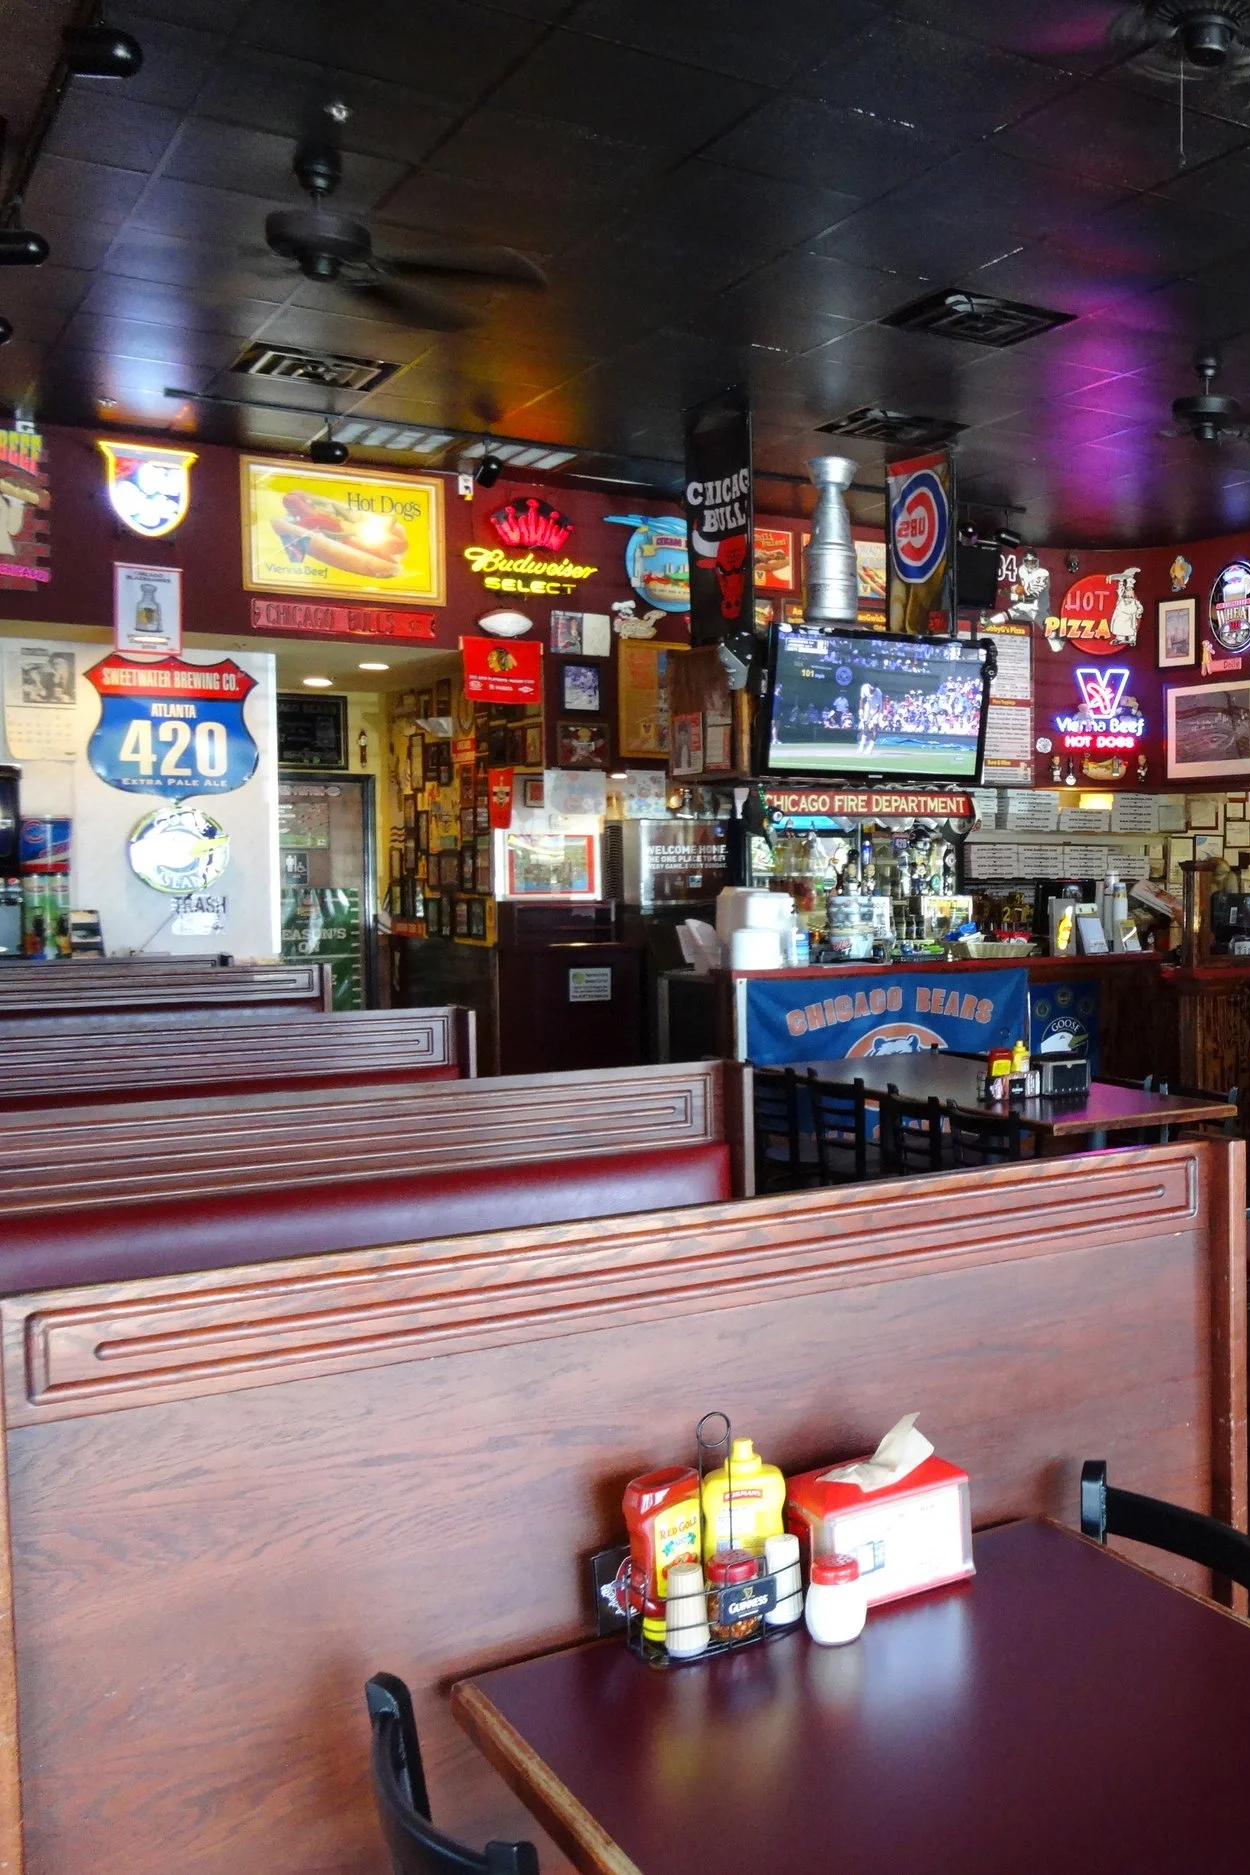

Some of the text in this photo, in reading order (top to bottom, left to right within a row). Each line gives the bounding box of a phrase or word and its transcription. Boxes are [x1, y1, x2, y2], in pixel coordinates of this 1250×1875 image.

[346, 492, 422, 522] Hot Dogs
[702, 501, 747, 533] BULL
[265, 563, 328, 579] Vienna Beef
[464, 547, 598, 579] Budweiser
[484, 577, 577, 595] SELECT
[1065, 590, 1110, 612] HOT
[265, 603, 334, 629] CHICAGO
[1044, 616, 1111, 639] PIZZA
[102, 667, 240, 691] SWEETWATER BREWING CO.
[801, 669, 814, 678] 101
[151, 703, 197, 718] ATLANTA
[1056, 717, 1145, 736] Vienna Beef
[119, 720, 228, 777] 420
[1064, 736, 1135, 749] HOT DOGS
[121, 778, 228, 788] EXTRA PALE ALE
[764, 794, 966, 814] CHICAGO FIRE DEPARTMENT
[648, 844, 697, 855] WELCOME
[175, 896, 226, 914] TRASH
[281, 928, 347, 940] EASON'S
[785, 986, 995, 1037] CHICAGO BEARS
[1051, 1018, 1080, 1033] GOOSE
[659, 1526, 678, 1540] RED
[728, 1593, 768, 1615] GUINNESS
